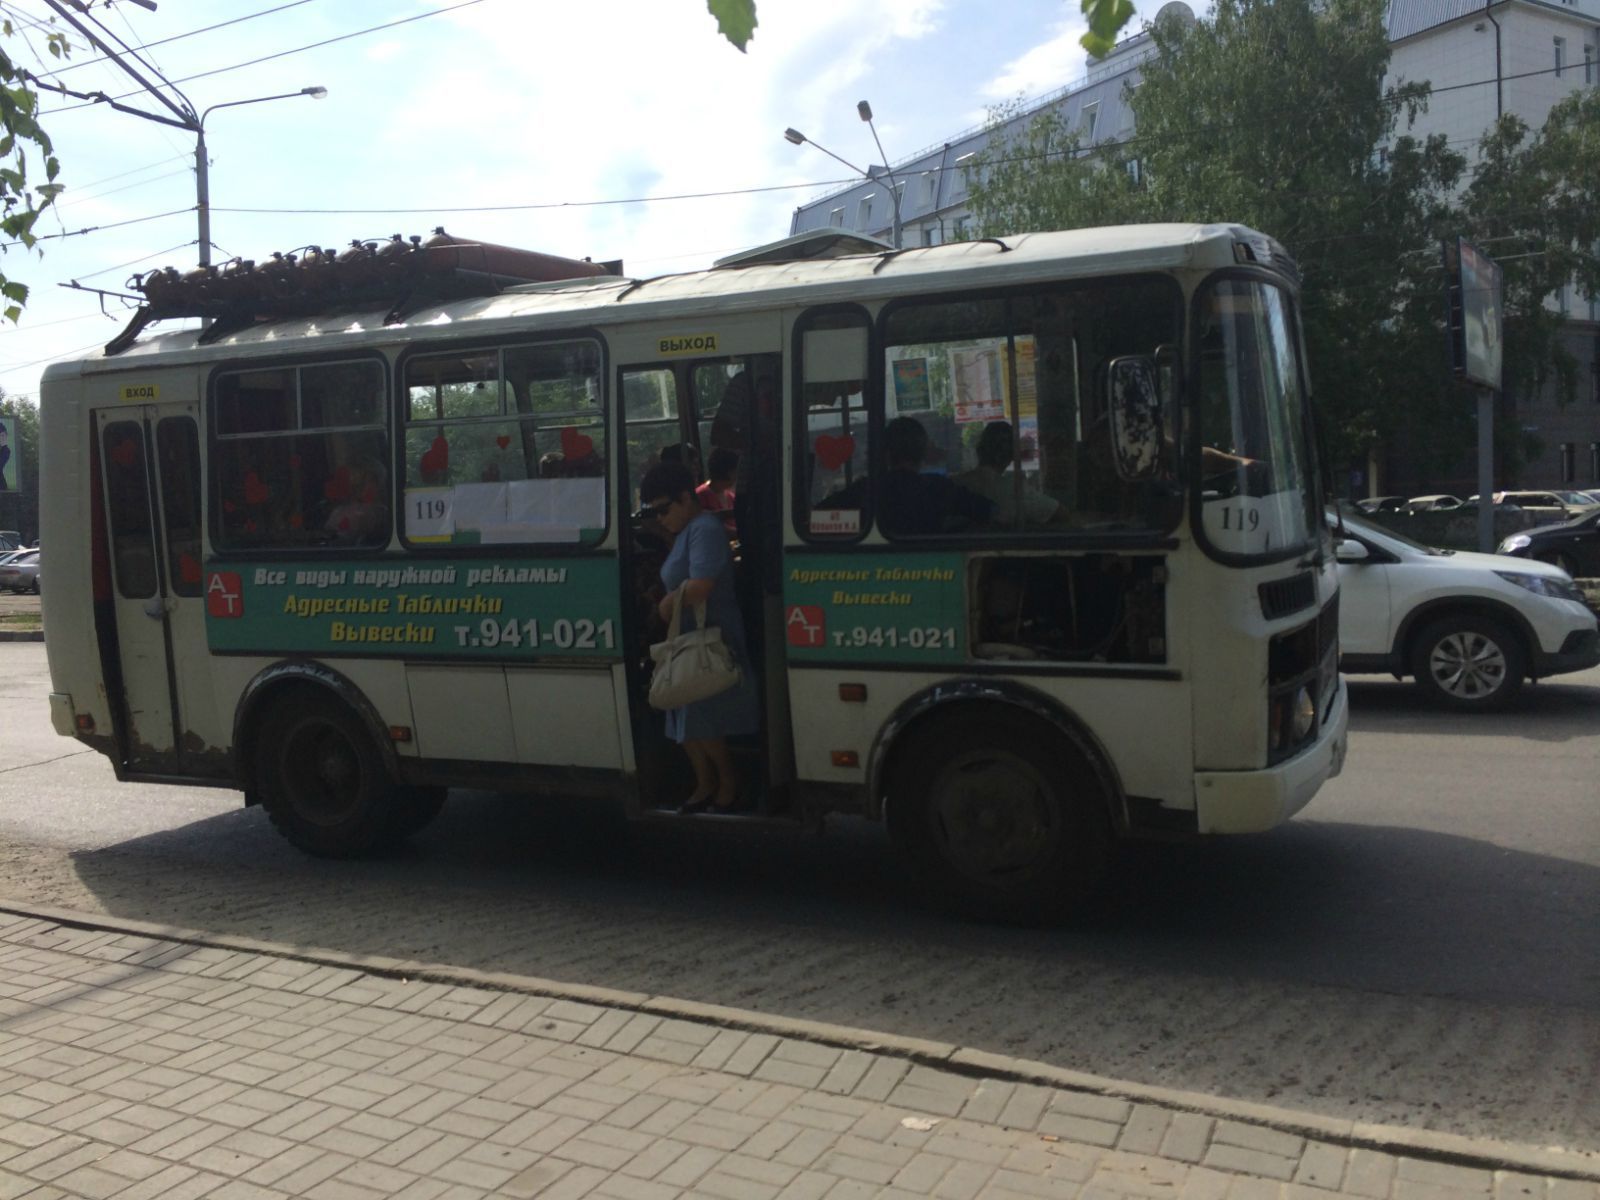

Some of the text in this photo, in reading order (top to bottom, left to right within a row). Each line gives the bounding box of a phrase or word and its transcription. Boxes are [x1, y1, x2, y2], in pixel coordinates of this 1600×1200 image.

[660, 336, 716, 352] ВЫХОД
[126, 386, 154, 398] ВХОД
[415, 499, 446, 520] 119
[1222, 506, 1260, 532] 119
[254, 565, 567, 588] Все виды наружной рекламы
[789, 567, 955, 584] Адресные Таблички
[284, 593, 503, 616] Адресные Таблички
[832, 591, 912, 605] Вывески
[331, 617, 614, 649] Вывески т.941-021
[832, 626, 956, 649] т.941-021
